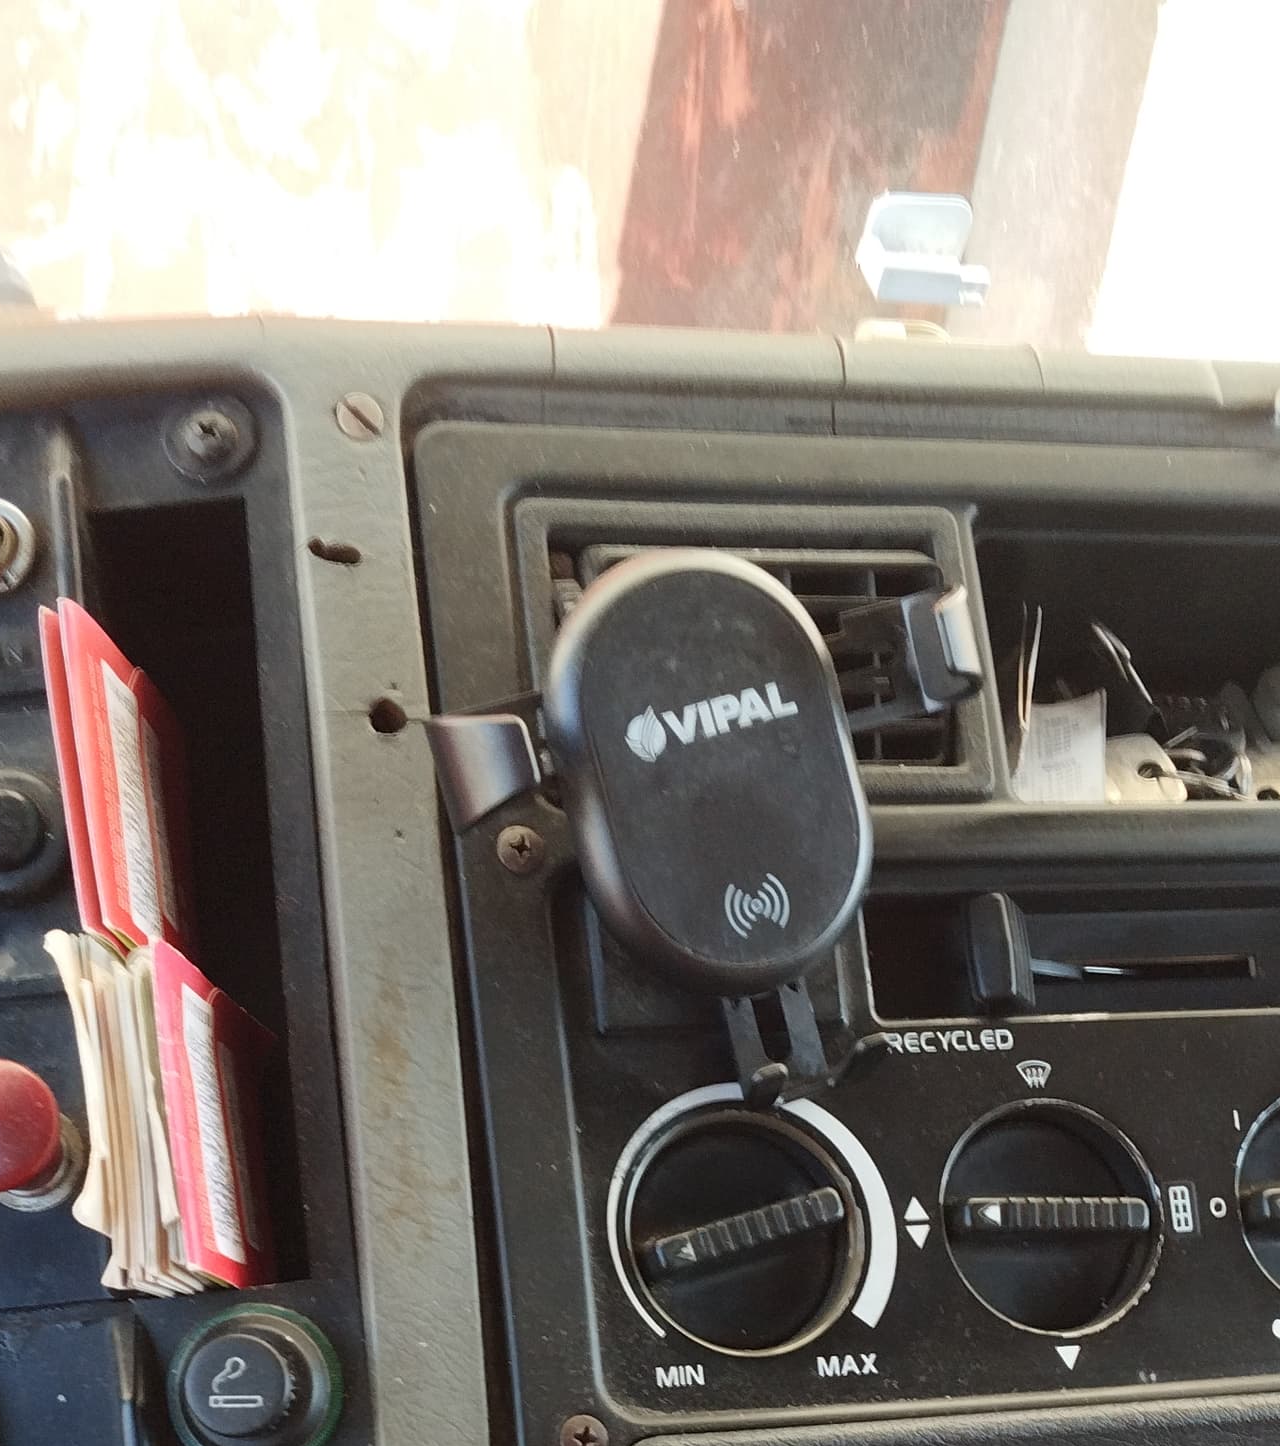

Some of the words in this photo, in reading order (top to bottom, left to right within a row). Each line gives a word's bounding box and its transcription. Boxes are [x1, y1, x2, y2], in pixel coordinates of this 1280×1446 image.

[661, 682, 799, 745] VIPAL
[884, 1029, 1014, 1055] RECYCLED
[655, 1364, 705, 1388] MIN
[817, 1353, 878, 1378] MAX
